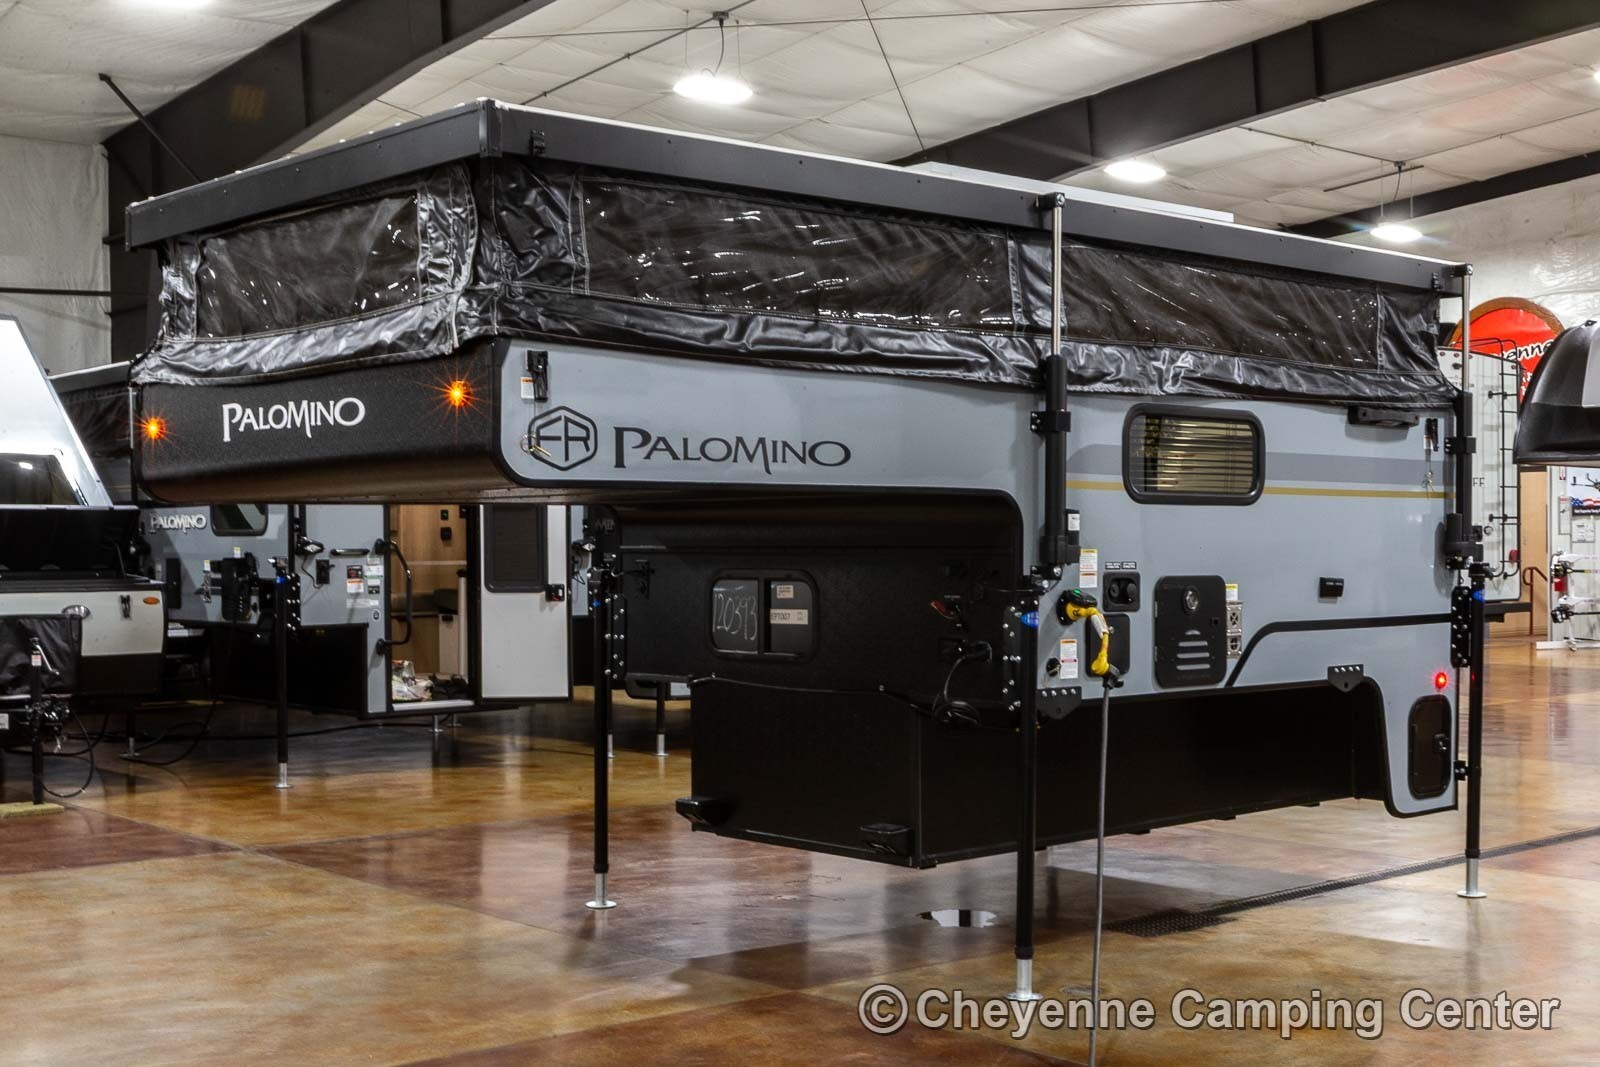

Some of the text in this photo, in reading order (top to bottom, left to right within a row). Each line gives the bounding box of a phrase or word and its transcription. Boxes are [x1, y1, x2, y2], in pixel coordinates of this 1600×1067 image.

[222, 397, 366, 442] PALOMINO
[613, 426, 852, 476] PALOMINO
[150, 513, 207, 534] PALOMINO
